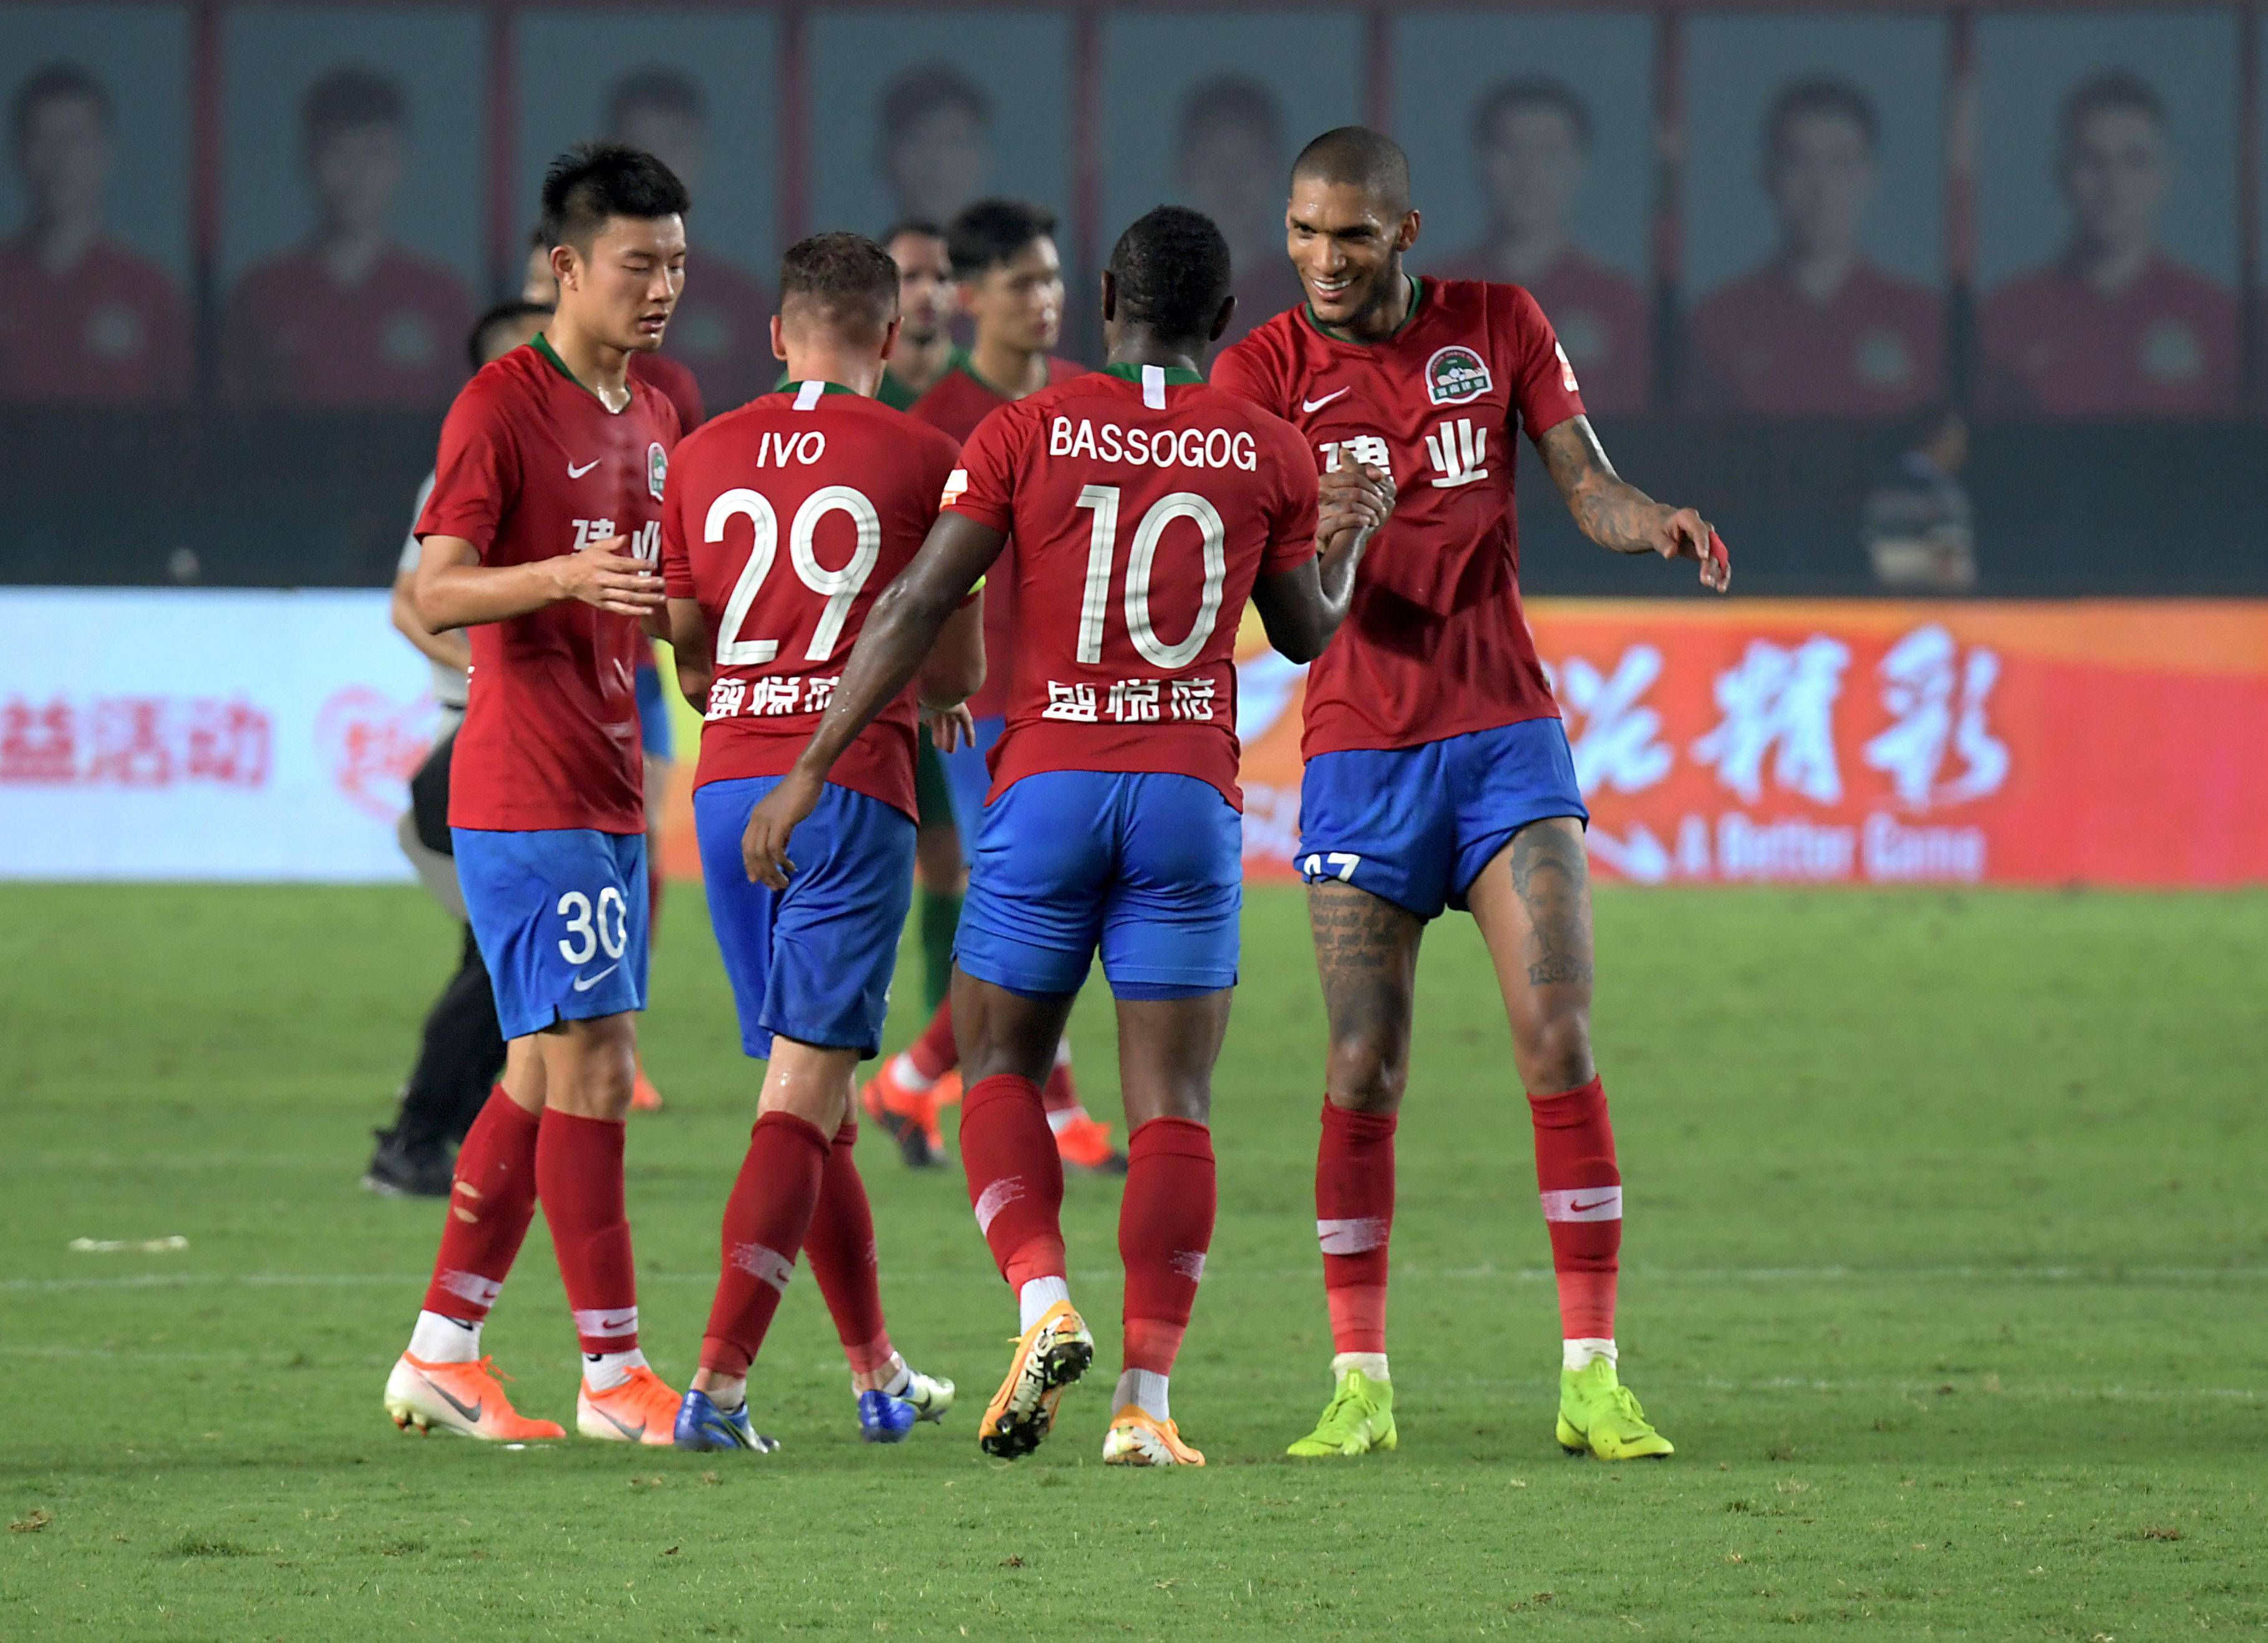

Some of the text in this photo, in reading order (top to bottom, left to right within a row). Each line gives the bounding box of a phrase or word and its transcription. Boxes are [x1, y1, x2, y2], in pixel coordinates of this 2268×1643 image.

[756, 431, 826, 468] IVO
[1049, 416, 1257, 472] BASSOGOG
[704, 485, 881, 666] 29
[1075, 483, 1226, 669] 10
[556, 886, 627, 964] 30
